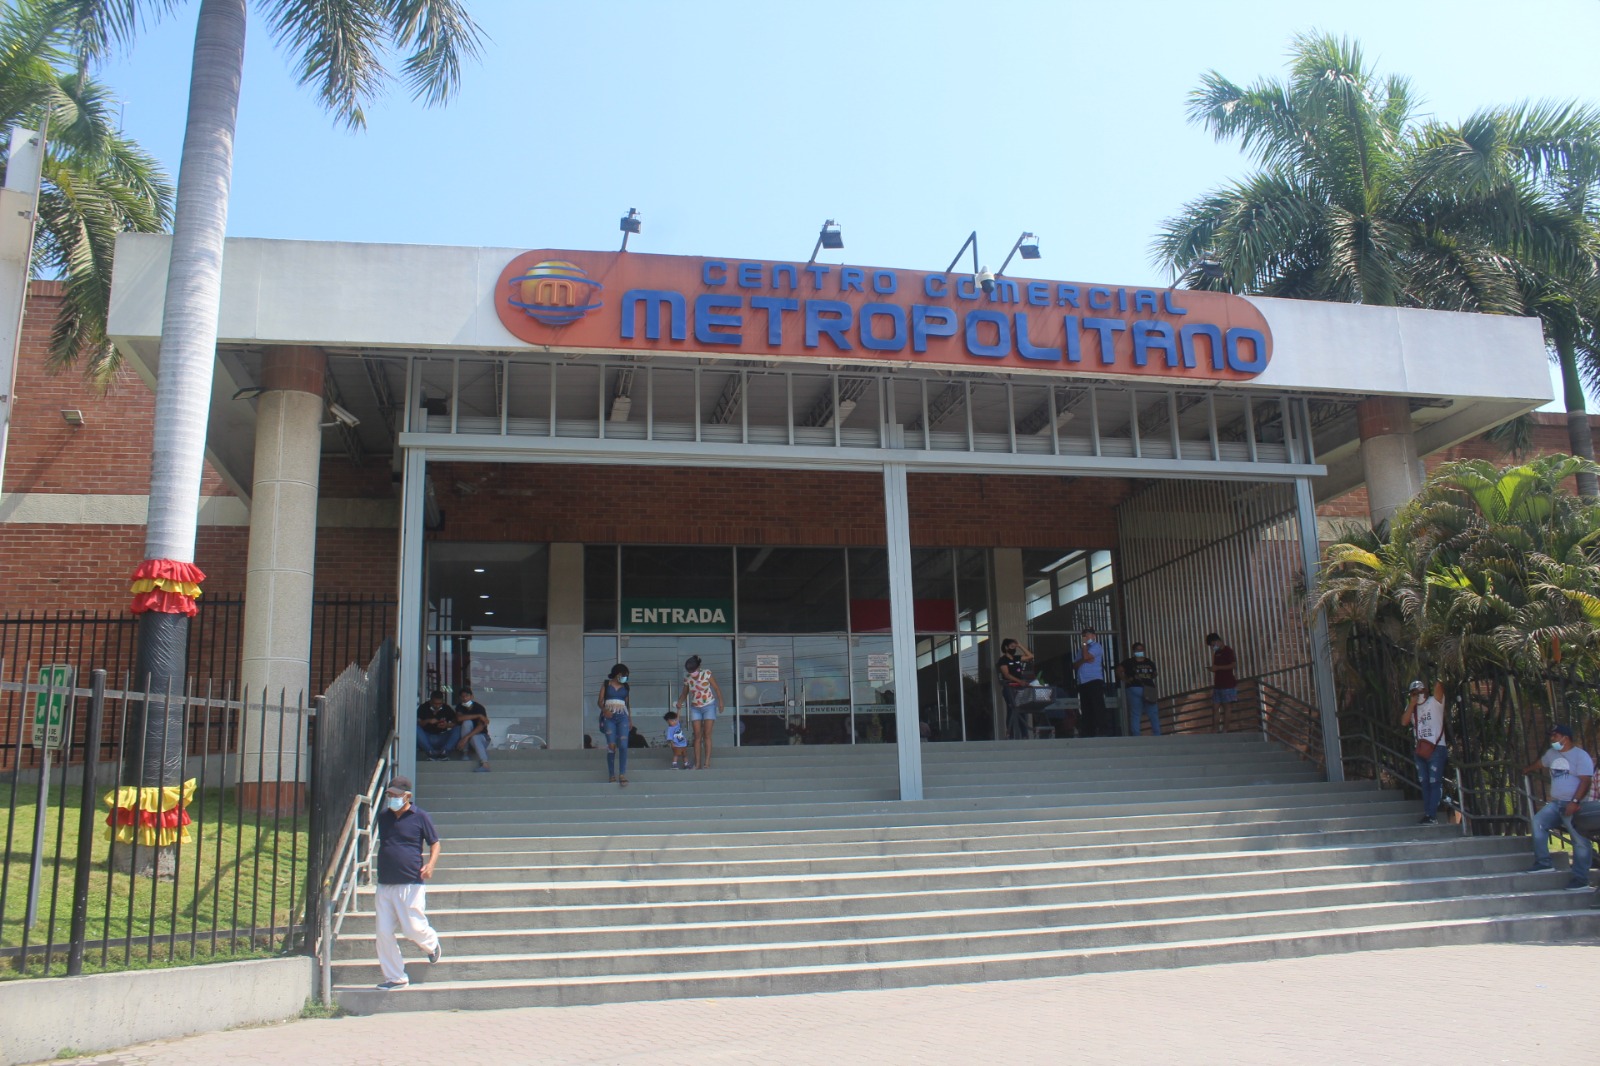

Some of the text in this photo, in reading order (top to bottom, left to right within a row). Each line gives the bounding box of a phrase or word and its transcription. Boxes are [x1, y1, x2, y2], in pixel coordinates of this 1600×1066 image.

[703, 261, 1188, 315] CENTRO COMERCIAL
[620, 289, 1267, 373] METROPOLITANO
[631, 608, 726, 623] ENTRADA
